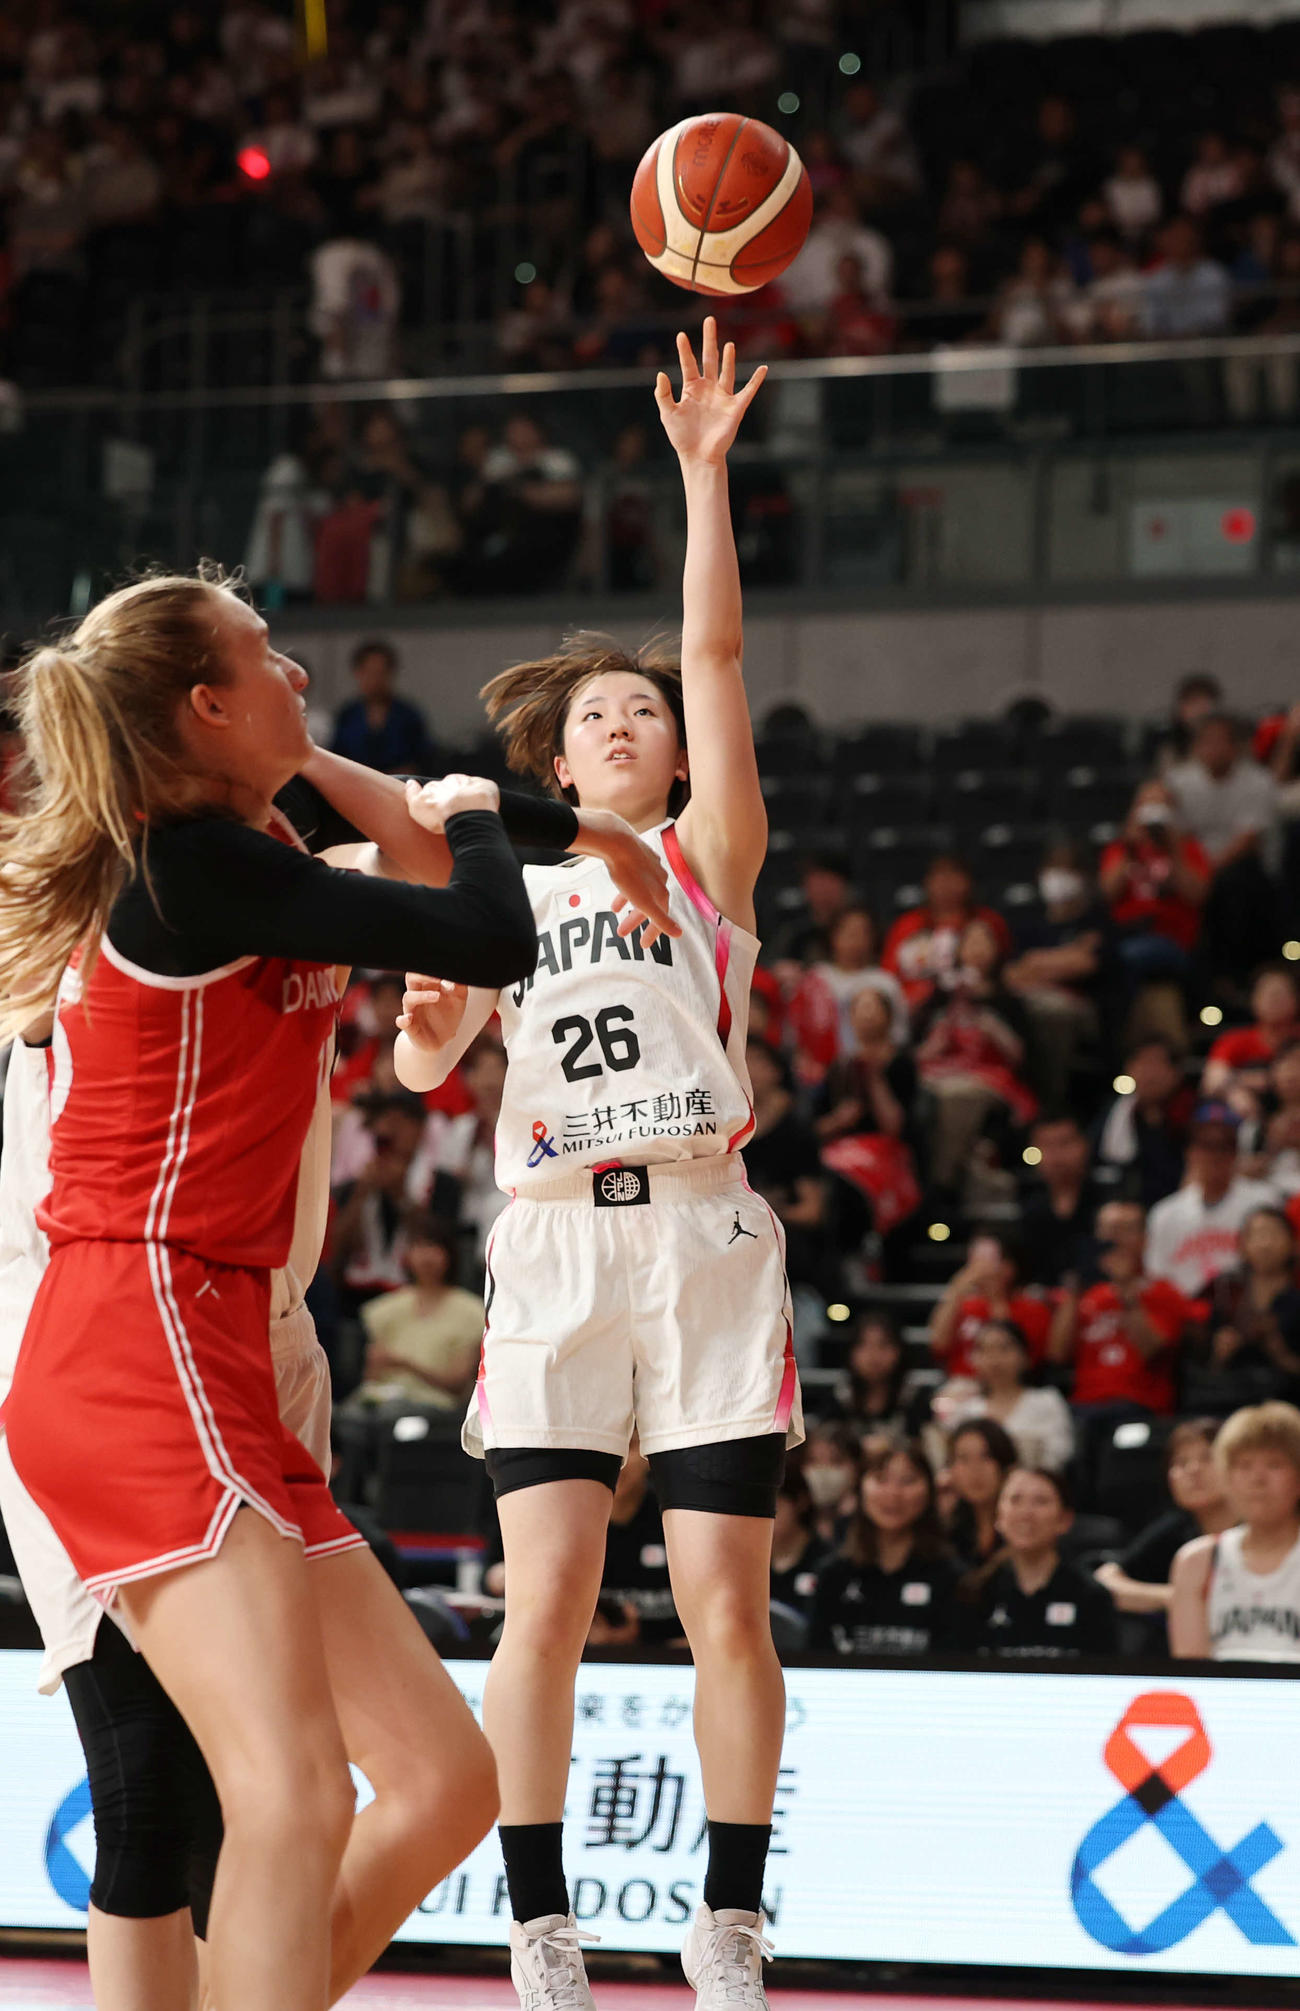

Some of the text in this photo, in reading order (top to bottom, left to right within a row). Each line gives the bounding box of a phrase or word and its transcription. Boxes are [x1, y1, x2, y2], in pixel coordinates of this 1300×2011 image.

[551, 1004, 641, 1083] 26
[562, 1088, 715, 1137] 三井不動産
[562, 1122, 717, 1154] MITSUI FUDOSAN
[616, 1173, 625, 1202] JPN
[490, 1873, 781, 1927] FDOSN
